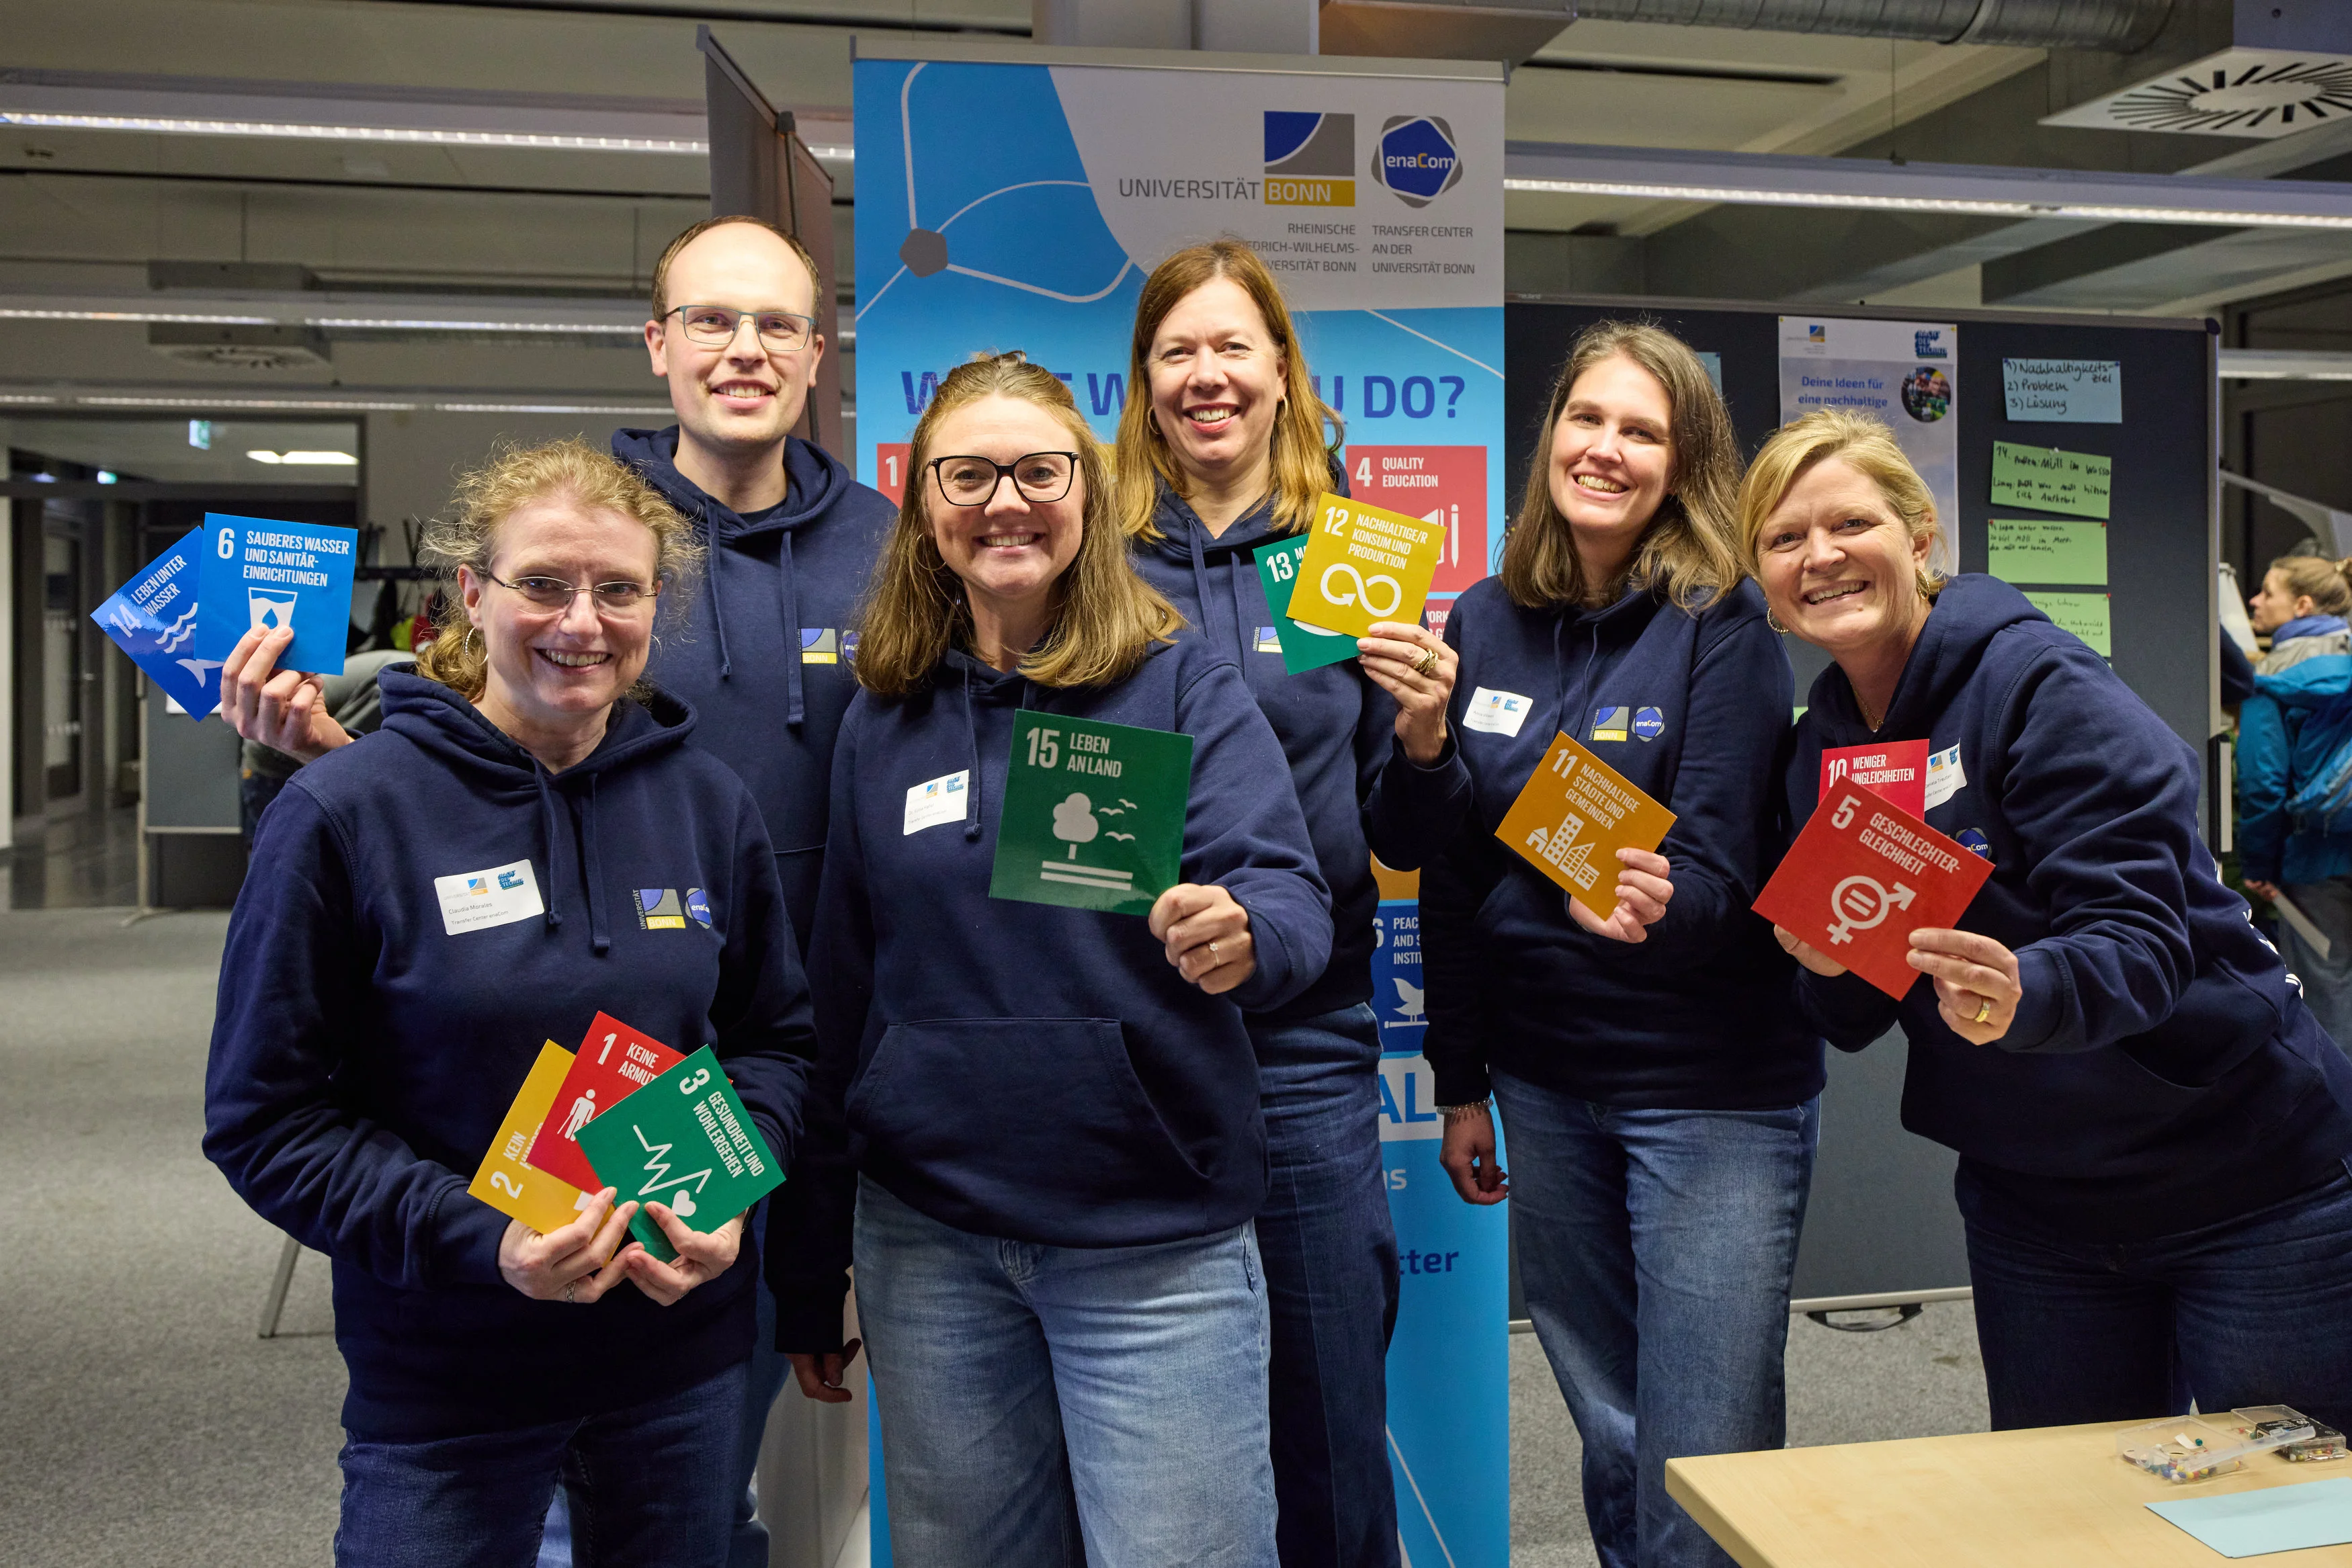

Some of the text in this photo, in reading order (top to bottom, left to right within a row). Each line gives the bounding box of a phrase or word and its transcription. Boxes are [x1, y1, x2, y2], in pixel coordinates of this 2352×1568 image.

[1386, 152, 1454, 170] enaCom
[1119, 177, 1331, 202] UNIVERSITÄT BONN
[1288, 223, 1356, 235] RHEINISCHE
[1372, 225, 1473, 238] TRANSFER CENTER
[1247, 241, 1360, 253] EDRICH-WILHELMS-
[1372, 243, 1412, 255] AN DER
[1266, 259, 1356, 272] VERSITÄT BONN
[1372, 261, 1475, 275] UNIVERSITÄT BONN
[1802, 376, 1884, 390] Deine Ideen für
[2007, 379, 2068, 392] 2) Problem
[1363, 376, 1466, 419] DO?
[1798, 394, 1888, 408] eine nachhaltige
[2009, 395, 2067, 415] 3) Lösung
[885, 455, 898, 486] 1
[1355, 457, 1373, 487] 4
[1382, 457, 1424, 470] QUALITY
[1382, 474, 1439, 488] EDUCATION
[1324, 506, 1349, 537] 12
[1356, 513, 1429, 545] NACHHALTIGE/R
[218, 527, 235, 560] 6
[246, 531, 349, 555] SAUBERES WASSER
[1352, 528, 1412, 556] KONSUM UND
[245, 548, 319, 568] UND SANITÄR-
[1266, 552, 1294, 583] 13
[1347, 542, 1407, 570] PRODUKTION
[131, 554, 187, 605] LEBEN UNTER
[243, 564, 329, 587] EINRICHTUNGEN
[142, 582, 181, 617] WASSER
[109, 604, 142, 638] 14
[1426, 610, 1450, 623] ORK
[803, 654, 829, 662] BONN
[1595, 732, 1618, 740] BONN
[1636, 720, 1662, 728] enaCom
[1026, 727, 1060, 769] 15
[1069, 732, 1110, 754] LEBEN
[1066, 754, 1122, 778] AN LAND
[1552, 748, 1579, 779] 11
[1828, 758, 1847, 788] 10
[1853, 754, 1887, 770] WENIGER
[1580, 763, 1641, 814] NACHHALTIGE
[1851, 767, 1915, 785] UNGLEICHHEITEN
[1564, 788, 1615, 831] GEMEINDEN
[1572, 775, 1626, 820] STÄDTE UND
[1831, 794, 1862, 830] 5
[1858, 828, 1928, 876] GLEICHHEIT
[1869, 812, 1961, 875] GESCHLECHTER-
[1966, 843, 1988, 853] aCom
[448, 902, 493, 914] Claudia Morales
[632, 889, 677, 930] UNIVERSITÄT BONN
[1372, 918, 1384, 948] 6
[1393, 917, 1419, 930] PEAC
[1393, 934, 1414, 947] AND
[1394, 951, 1423, 965] INSTIT
[597, 1032, 618, 1065] 1
[626, 1042, 659, 1070] KEINE
[679, 1068, 710, 1095] 3
[1379, 1072, 1437, 1124] AL
[503, 1131, 527, 1162] KEIN
[693, 1100, 745, 1178] WOHLERGEHEN
[708, 1090, 765, 1177] GESUNDHEIT UND
[490, 1170, 524, 1201] 2
